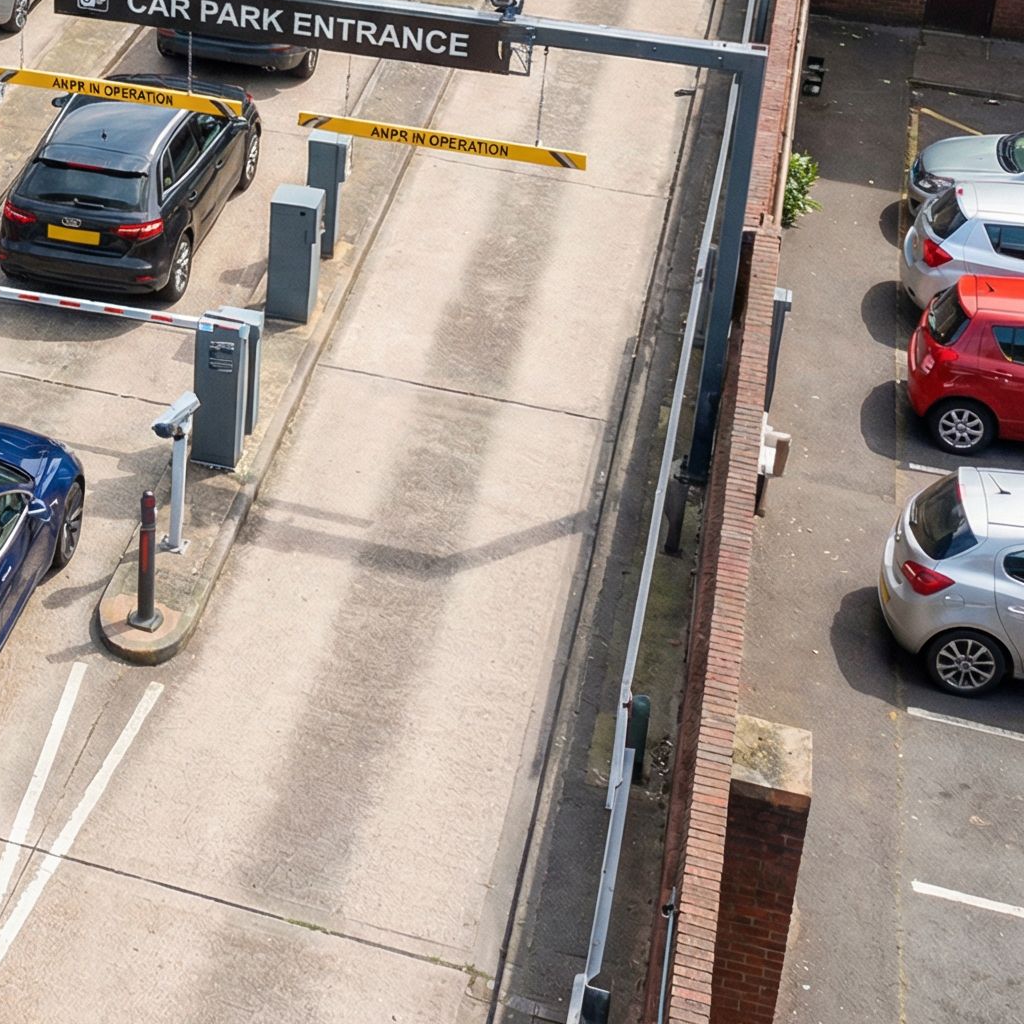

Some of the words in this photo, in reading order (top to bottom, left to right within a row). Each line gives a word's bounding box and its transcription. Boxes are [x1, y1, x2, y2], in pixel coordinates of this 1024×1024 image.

[199, 0, 285, 33] PARK
[292, 11, 470, 58] ENTRANCE
[89, 82, 101, 95] IN
[104, 85, 174, 106] OPERATION
[370, 126, 408, 142] ANPR
[412, 132, 426, 145] IN
[429, 134, 509, 157] OPERATION
